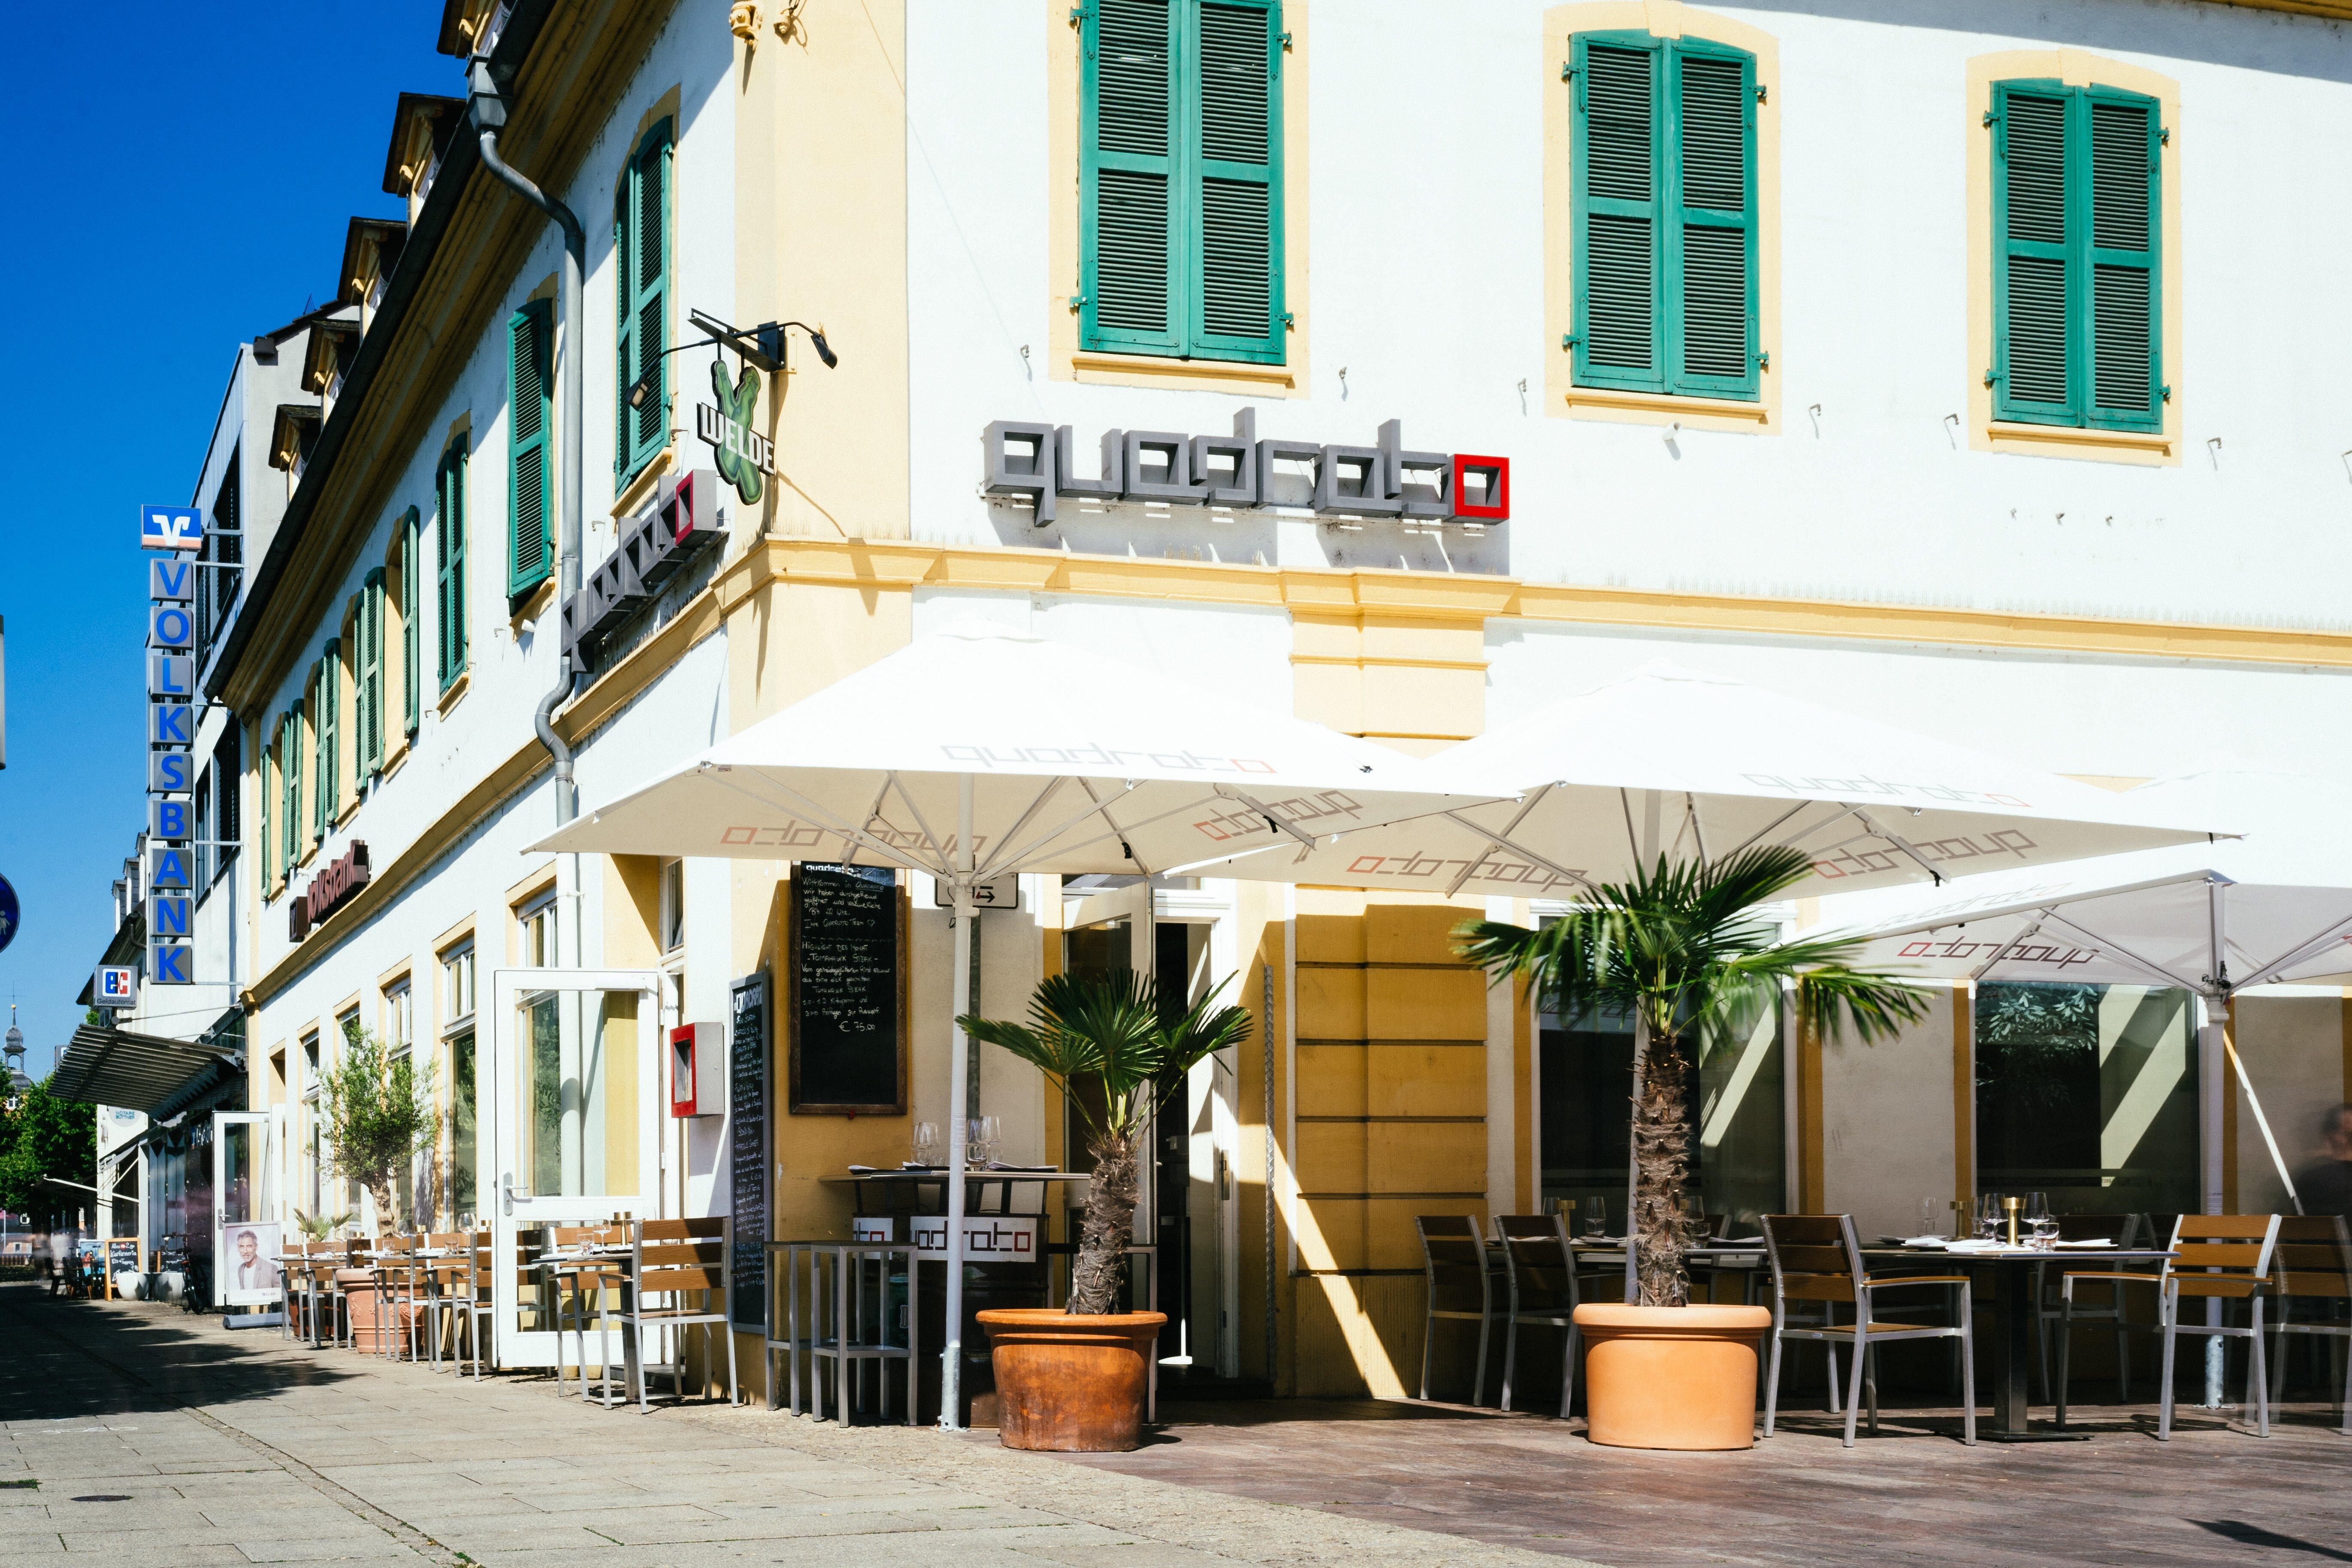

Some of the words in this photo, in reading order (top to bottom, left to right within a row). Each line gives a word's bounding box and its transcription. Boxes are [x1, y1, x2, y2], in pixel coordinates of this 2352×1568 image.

[702, 403, 774, 474] WELDE
[984, 406, 1509, 527] quadrato
[155, 562, 189, 981] VOLKSBANK
[940, 742, 1278, 773] quadrato
[1739, 774, 2033, 807] quadrato
[839, 891, 877, 901] durchgehend
[801, 963, 813, 972] Vom
[838, 1021, 850, 1032] €
